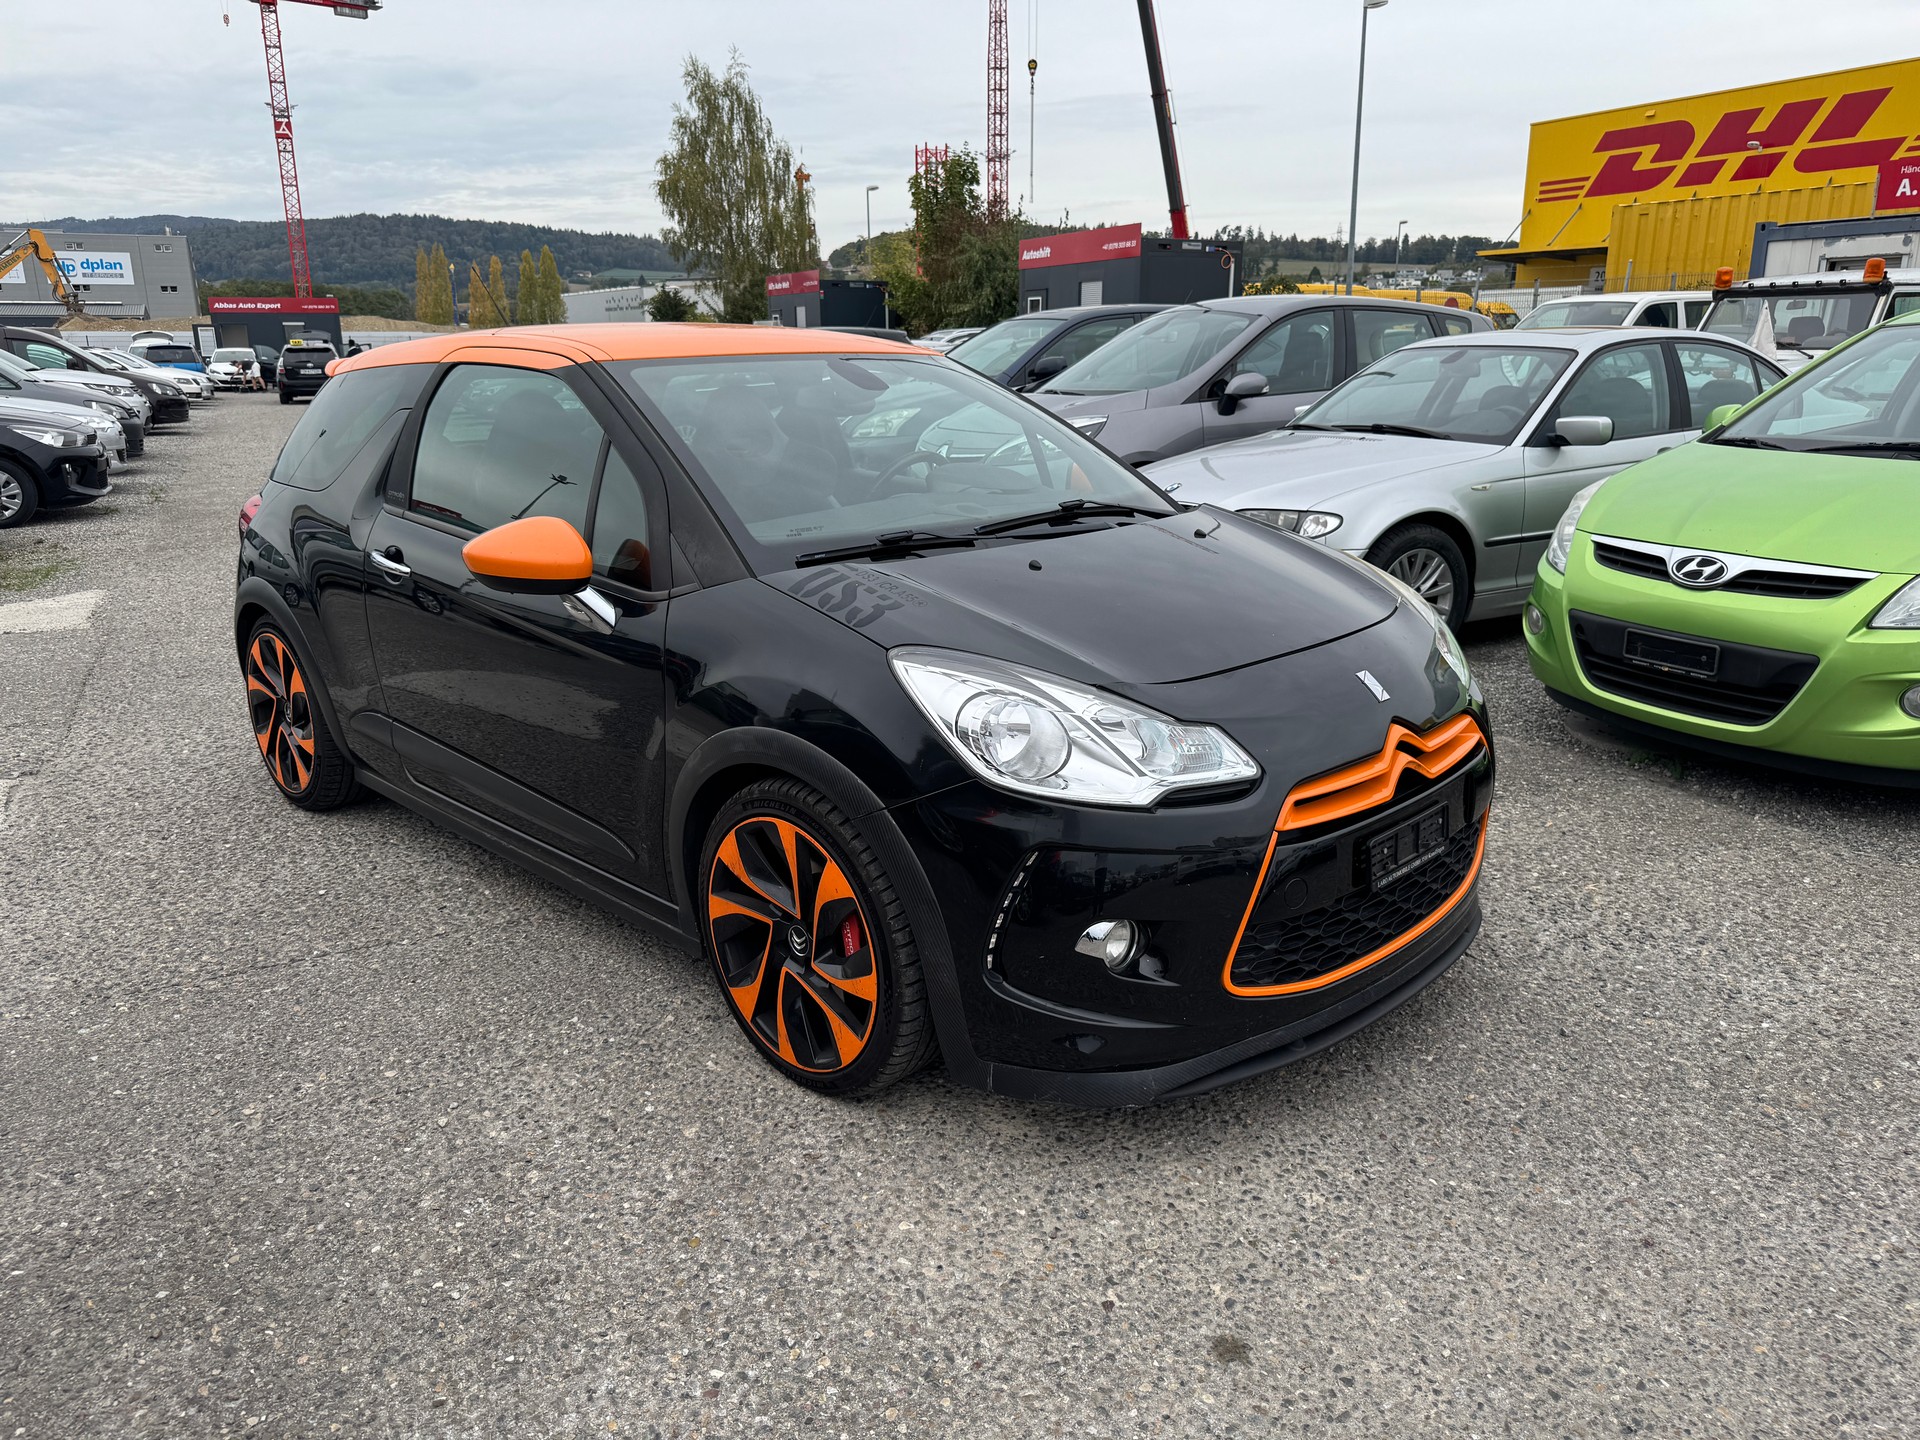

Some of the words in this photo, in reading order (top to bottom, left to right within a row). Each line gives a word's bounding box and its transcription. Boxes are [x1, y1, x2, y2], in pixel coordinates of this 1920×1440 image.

[1584, 86, 1908, 198] DHL
[1895, 178, 1918, 197] A.
[1022, 246, 1051, 260] Autoshift
[80, 258, 123, 272] dplan
[753, 799, 797, 816] MICHELIN
